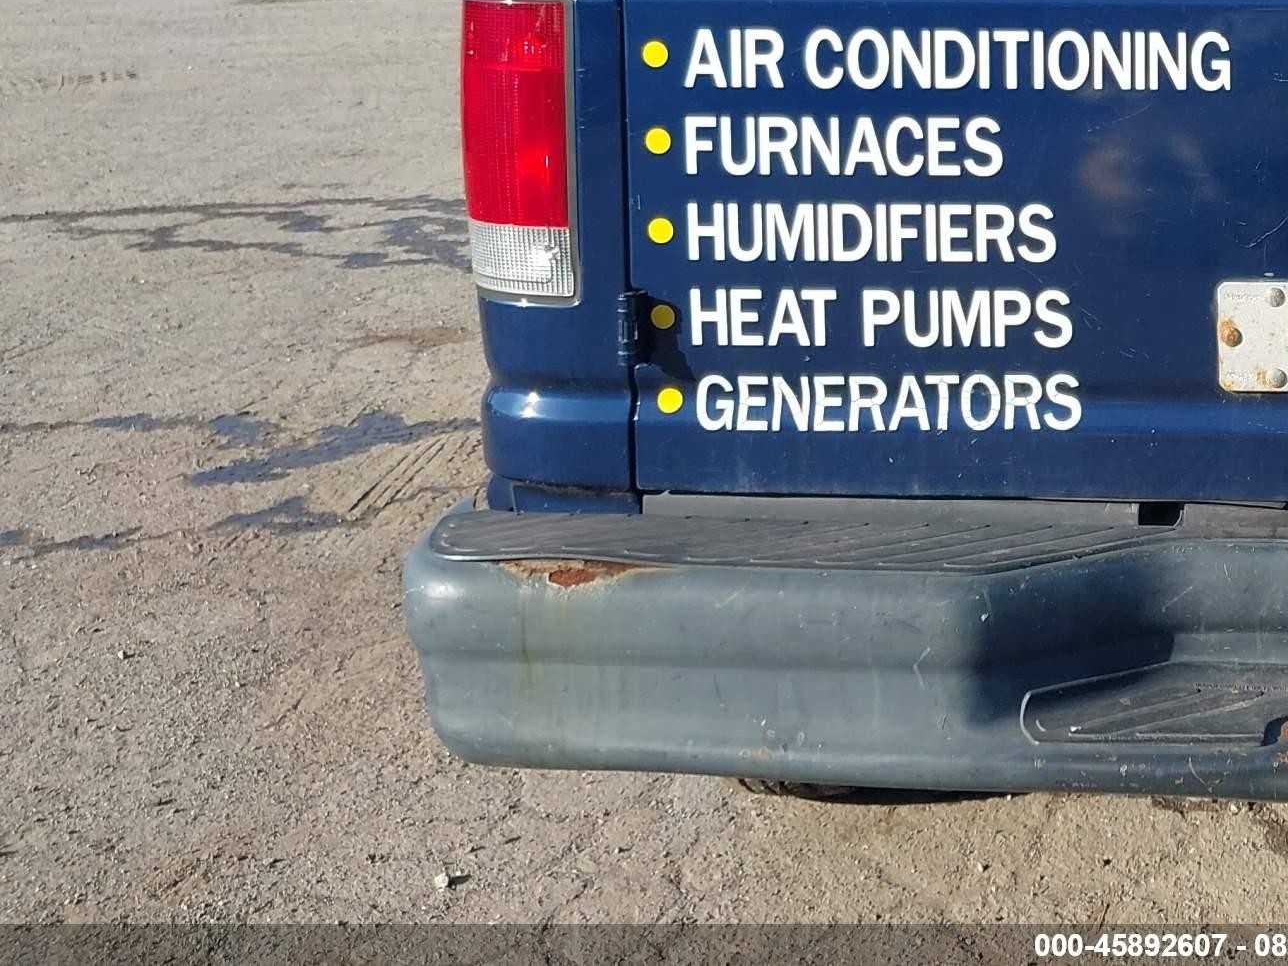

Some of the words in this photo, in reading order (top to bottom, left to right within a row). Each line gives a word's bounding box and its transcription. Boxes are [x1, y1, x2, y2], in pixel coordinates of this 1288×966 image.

[683, 28, 784, 89] AIR
[804, 28, 1232, 92] CONDITIONING
[683, 115, 1004, 177] FURNACES
[686, 202, 1058, 263] HUMIDIFIERS
[688, 288, 837, 348] HEAT
[861, 289, 1074, 349] PUMPS
[695, 373, 1083, 432] GENERATORS
